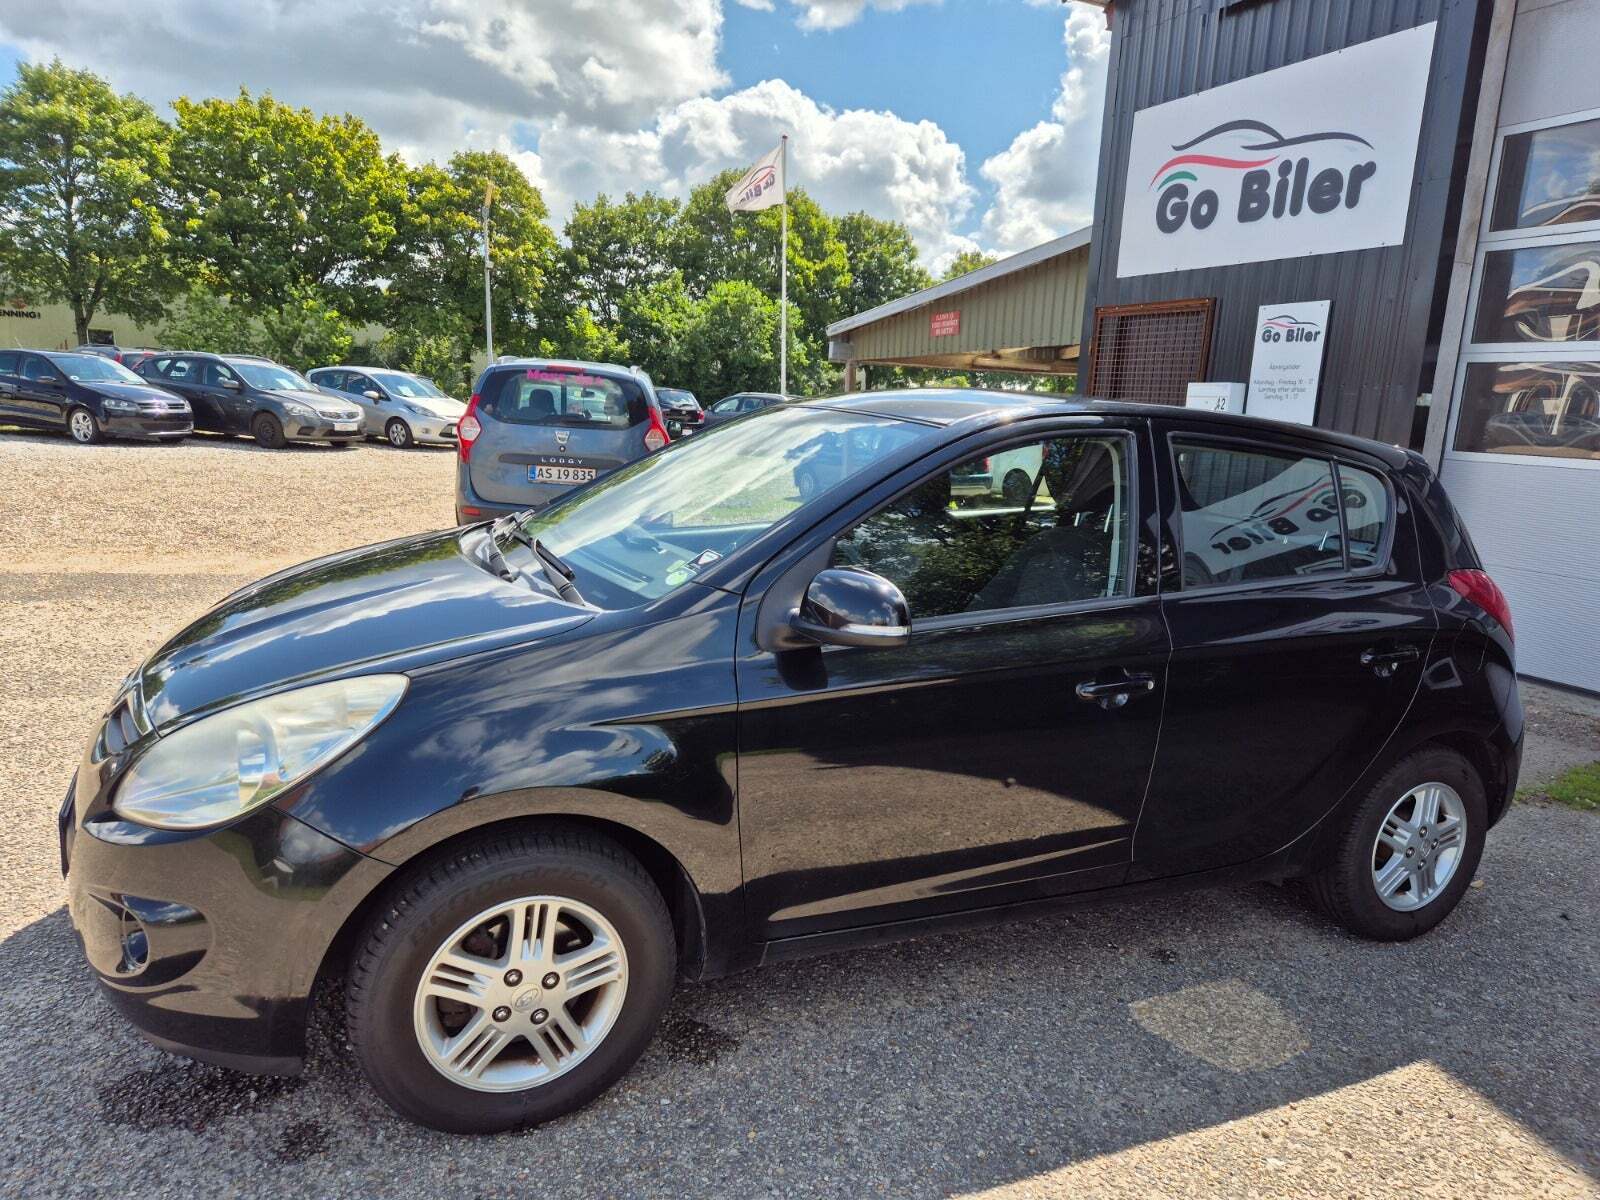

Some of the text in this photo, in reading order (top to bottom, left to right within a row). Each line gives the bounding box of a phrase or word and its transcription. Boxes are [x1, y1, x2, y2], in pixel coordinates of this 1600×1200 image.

[1156, 157, 1376, 233] Go Biler
[1262, 327, 1321, 343] Go Biler
[538, 468, 553, 479] AS
[557, 469, 570, 480] 19
[572, 470, 594, 480] 835
